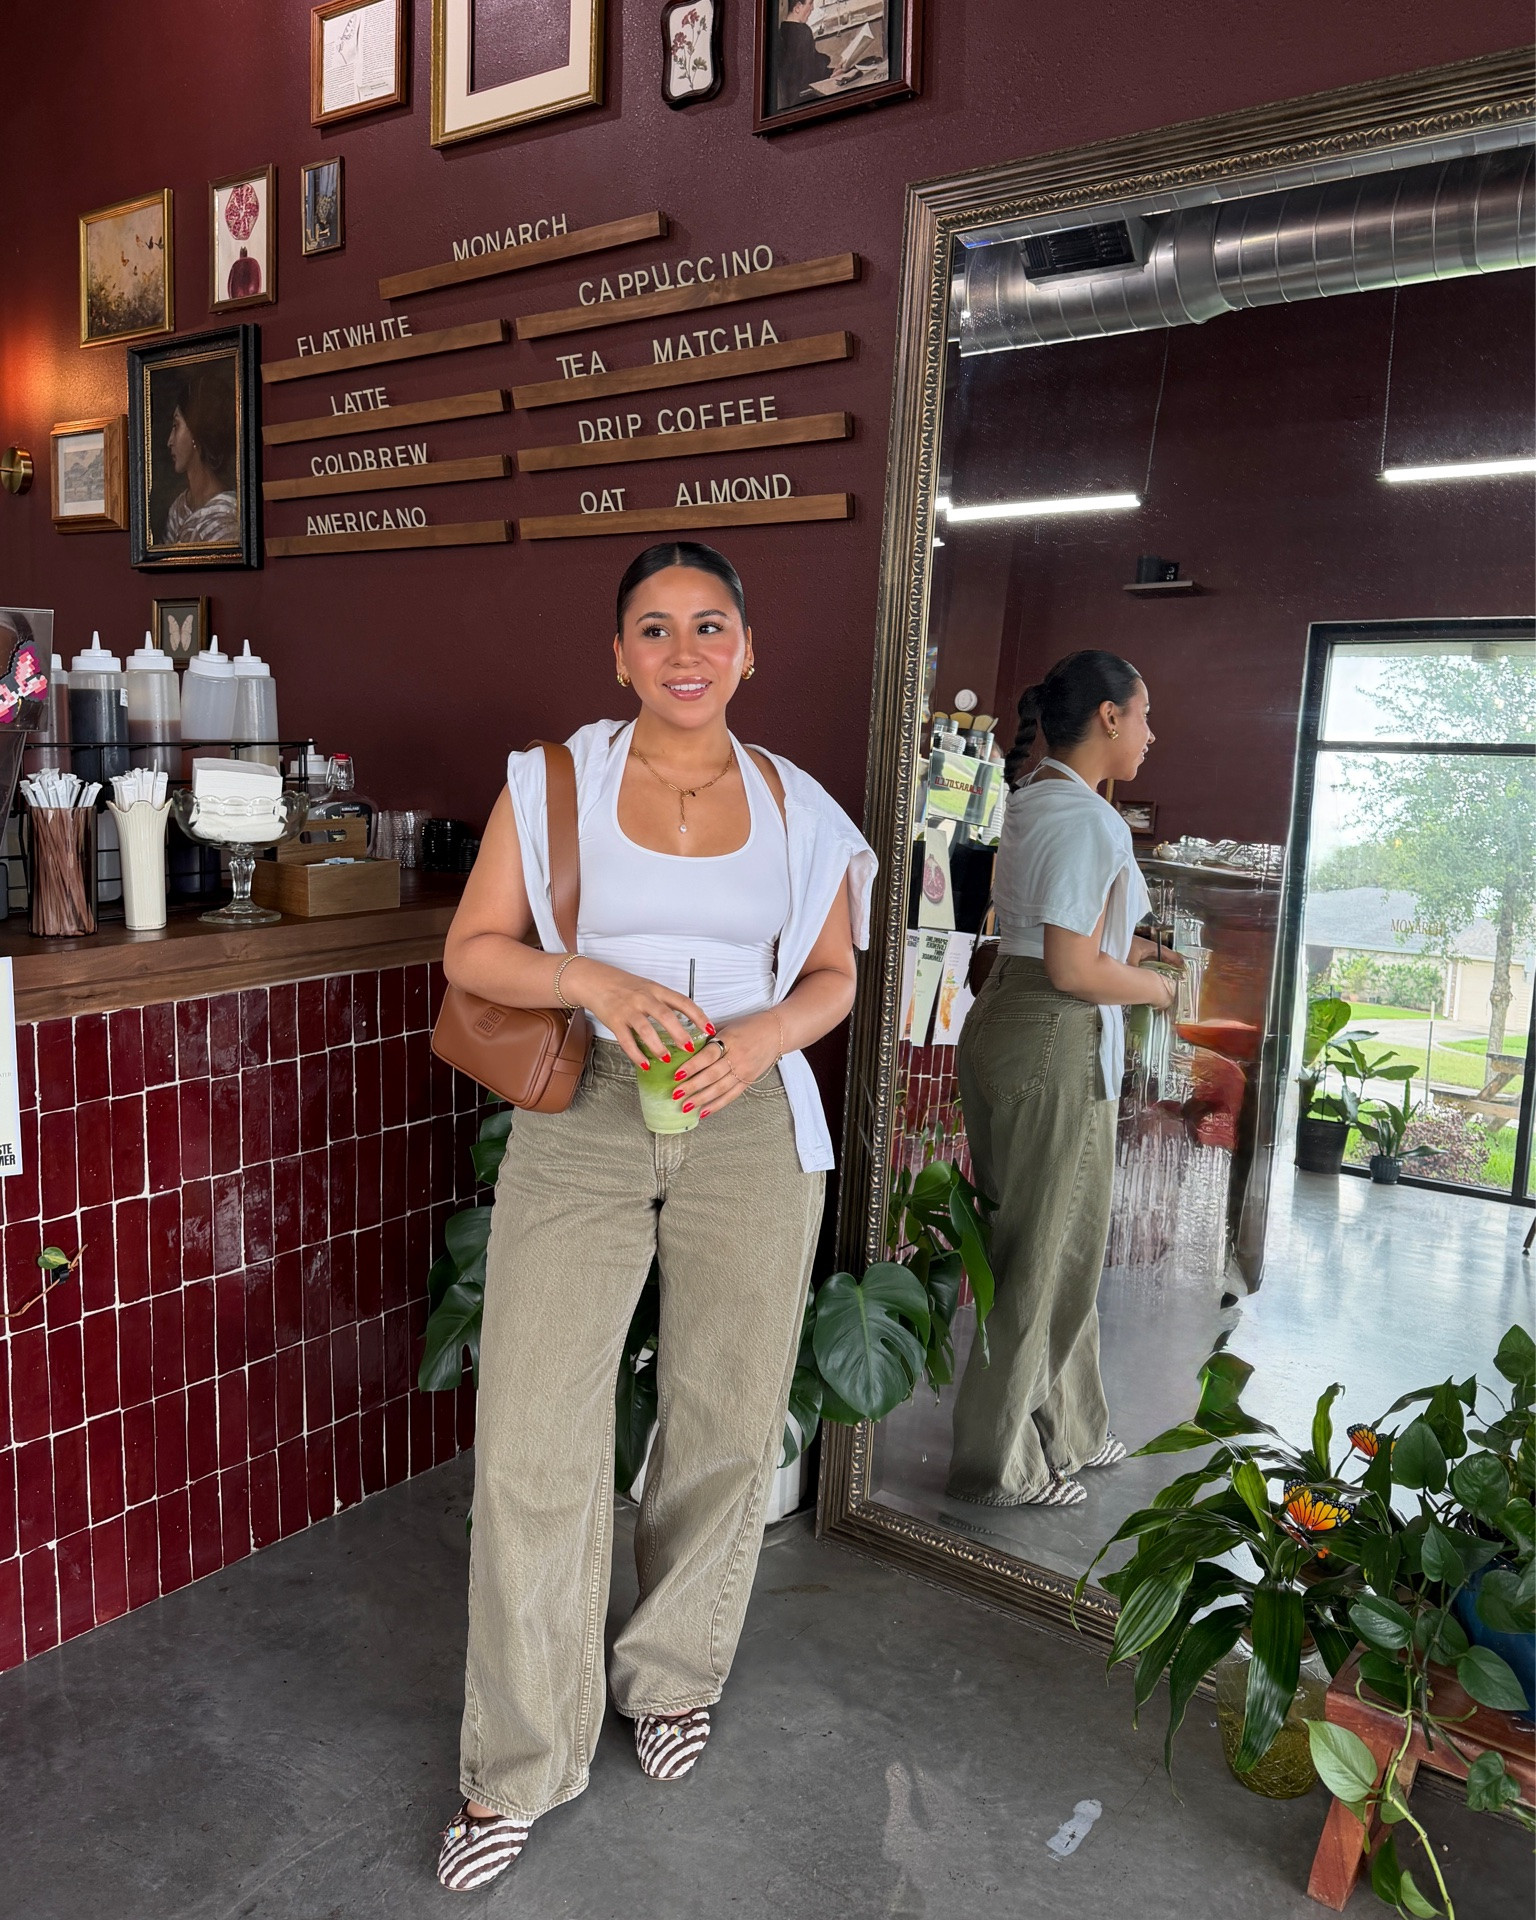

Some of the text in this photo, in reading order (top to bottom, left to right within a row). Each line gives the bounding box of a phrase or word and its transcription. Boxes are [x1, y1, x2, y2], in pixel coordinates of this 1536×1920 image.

[452, 213, 568, 261] MONARCH
[578, 245, 773, 307] CAPPUCCINO
[556, 319, 779, 380] TEA MATCHA
[330, 387, 392, 417] LATTE
[578, 396, 778, 444] DRIP COFFEE
[311, 443, 428, 478] COLDBREW
[580, 474, 794, 514] OAT ALMOND
[306, 507, 428, 536] AMERICANO
